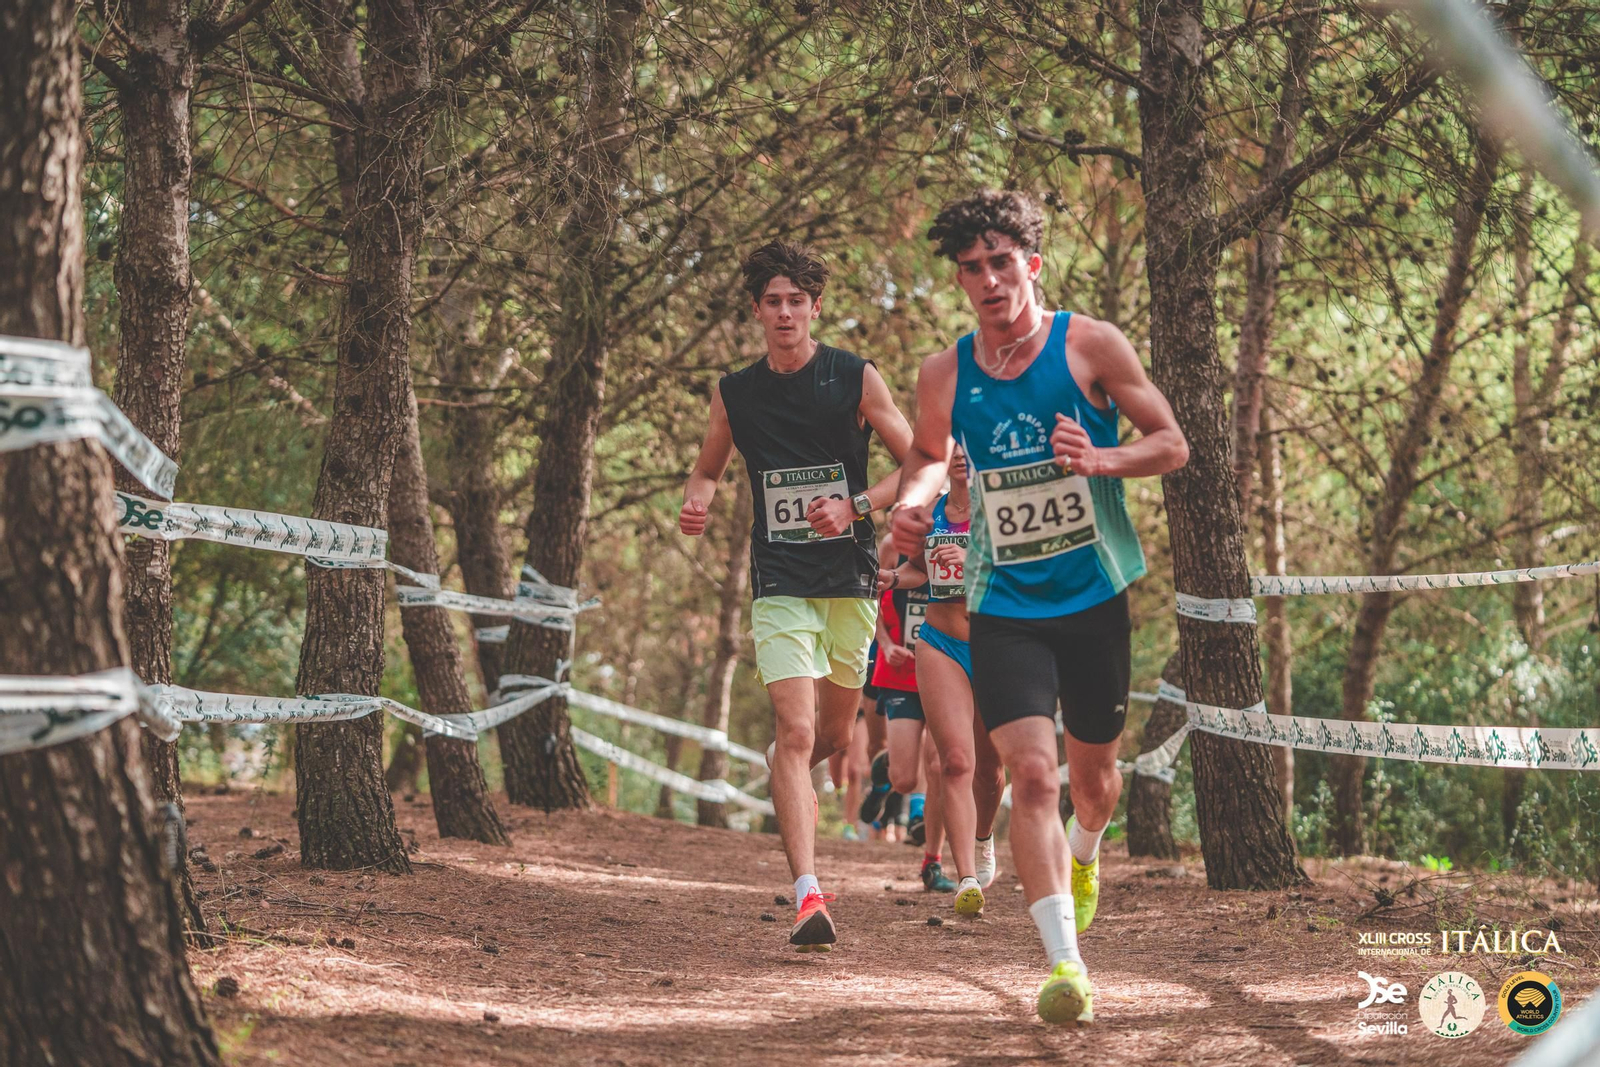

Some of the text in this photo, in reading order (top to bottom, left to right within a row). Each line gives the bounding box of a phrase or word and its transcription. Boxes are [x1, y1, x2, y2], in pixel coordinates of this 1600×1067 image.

[786, 470, 825, 481] ITÁLICA
[774, 493, 843, 524] 61
[997, 492, 1085, 536] 8243
